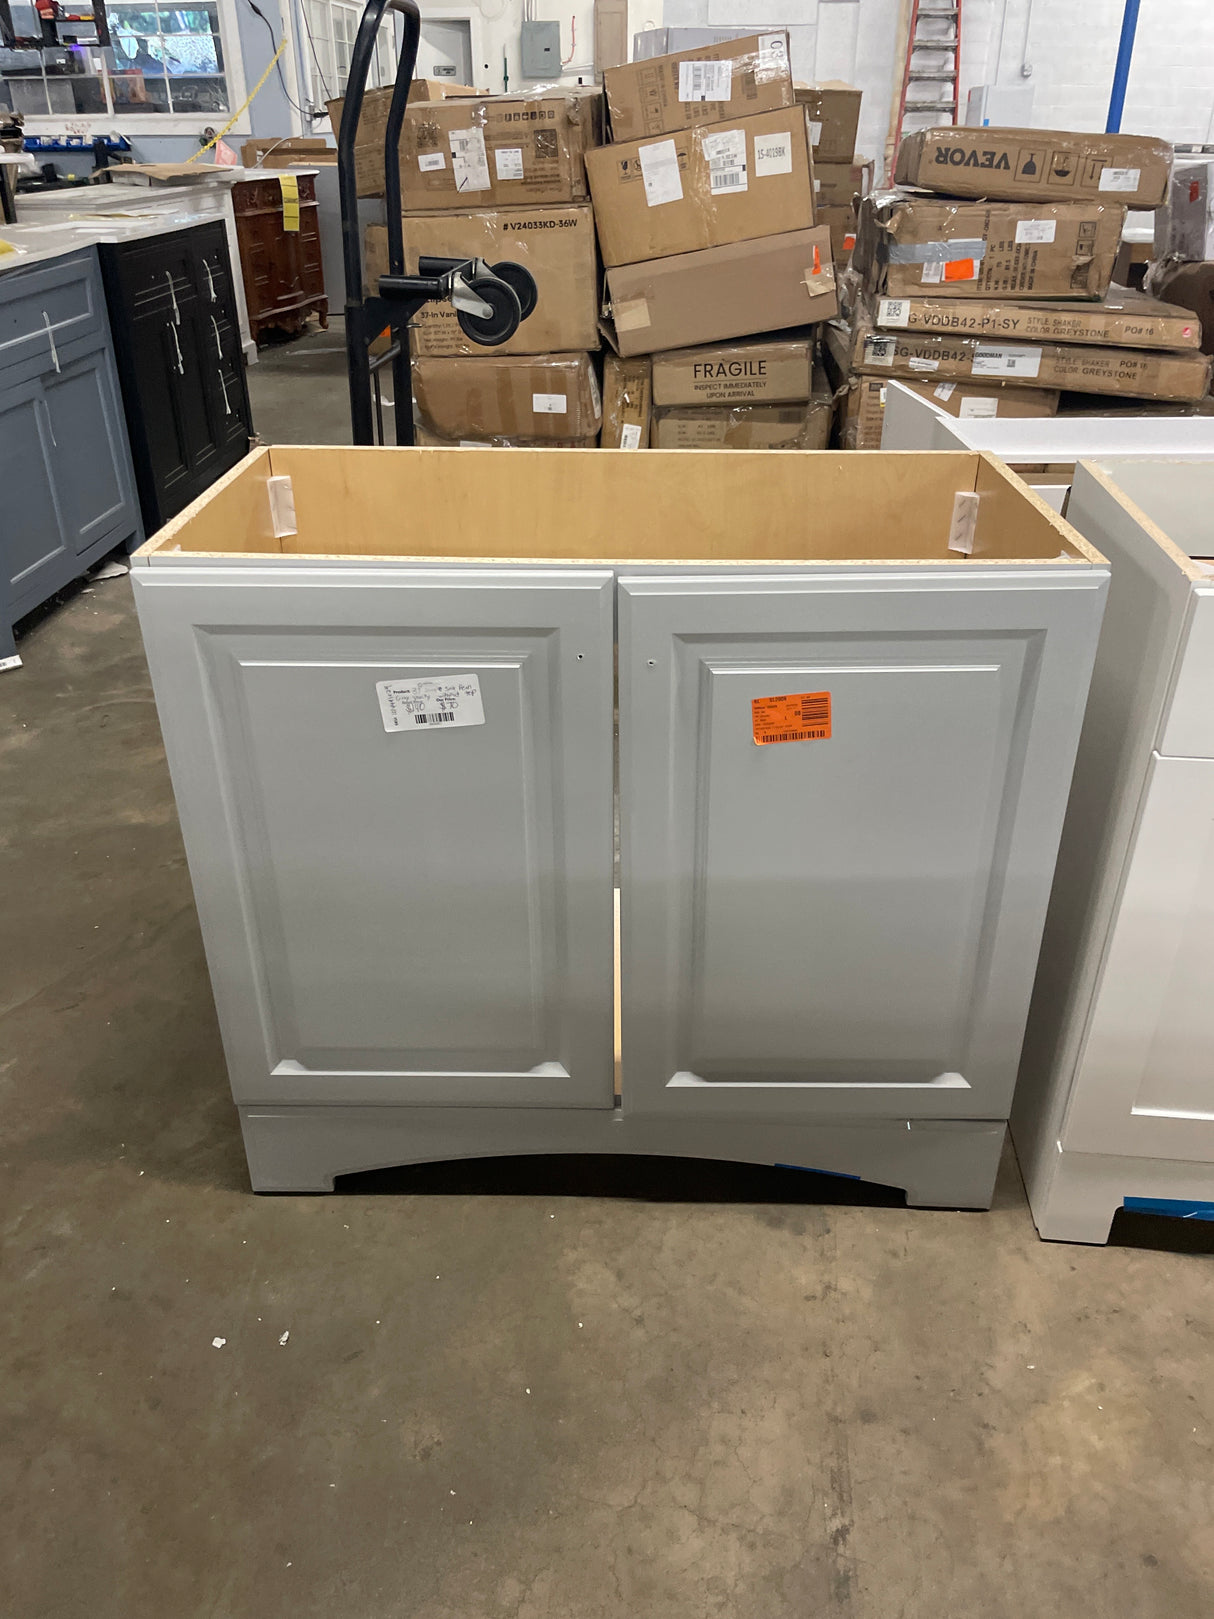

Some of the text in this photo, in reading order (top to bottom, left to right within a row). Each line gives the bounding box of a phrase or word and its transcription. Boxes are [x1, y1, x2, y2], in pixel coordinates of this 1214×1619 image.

[935, 146, 1010, 170] VEVOR
[1052, 318, 1082, 328] SHAKER
[1053, 327, 1110, 339] GREYSTONE
[1124, 325, 1143, 335] PO#
[693, 360, 767, 378] FRAGILE
[1120, 360, 1138, 369] PO#
[1082, 367, 1138, 380] GREYSTONE
[694, 381, 767, 391] INSPECT IMMEDIATELY
